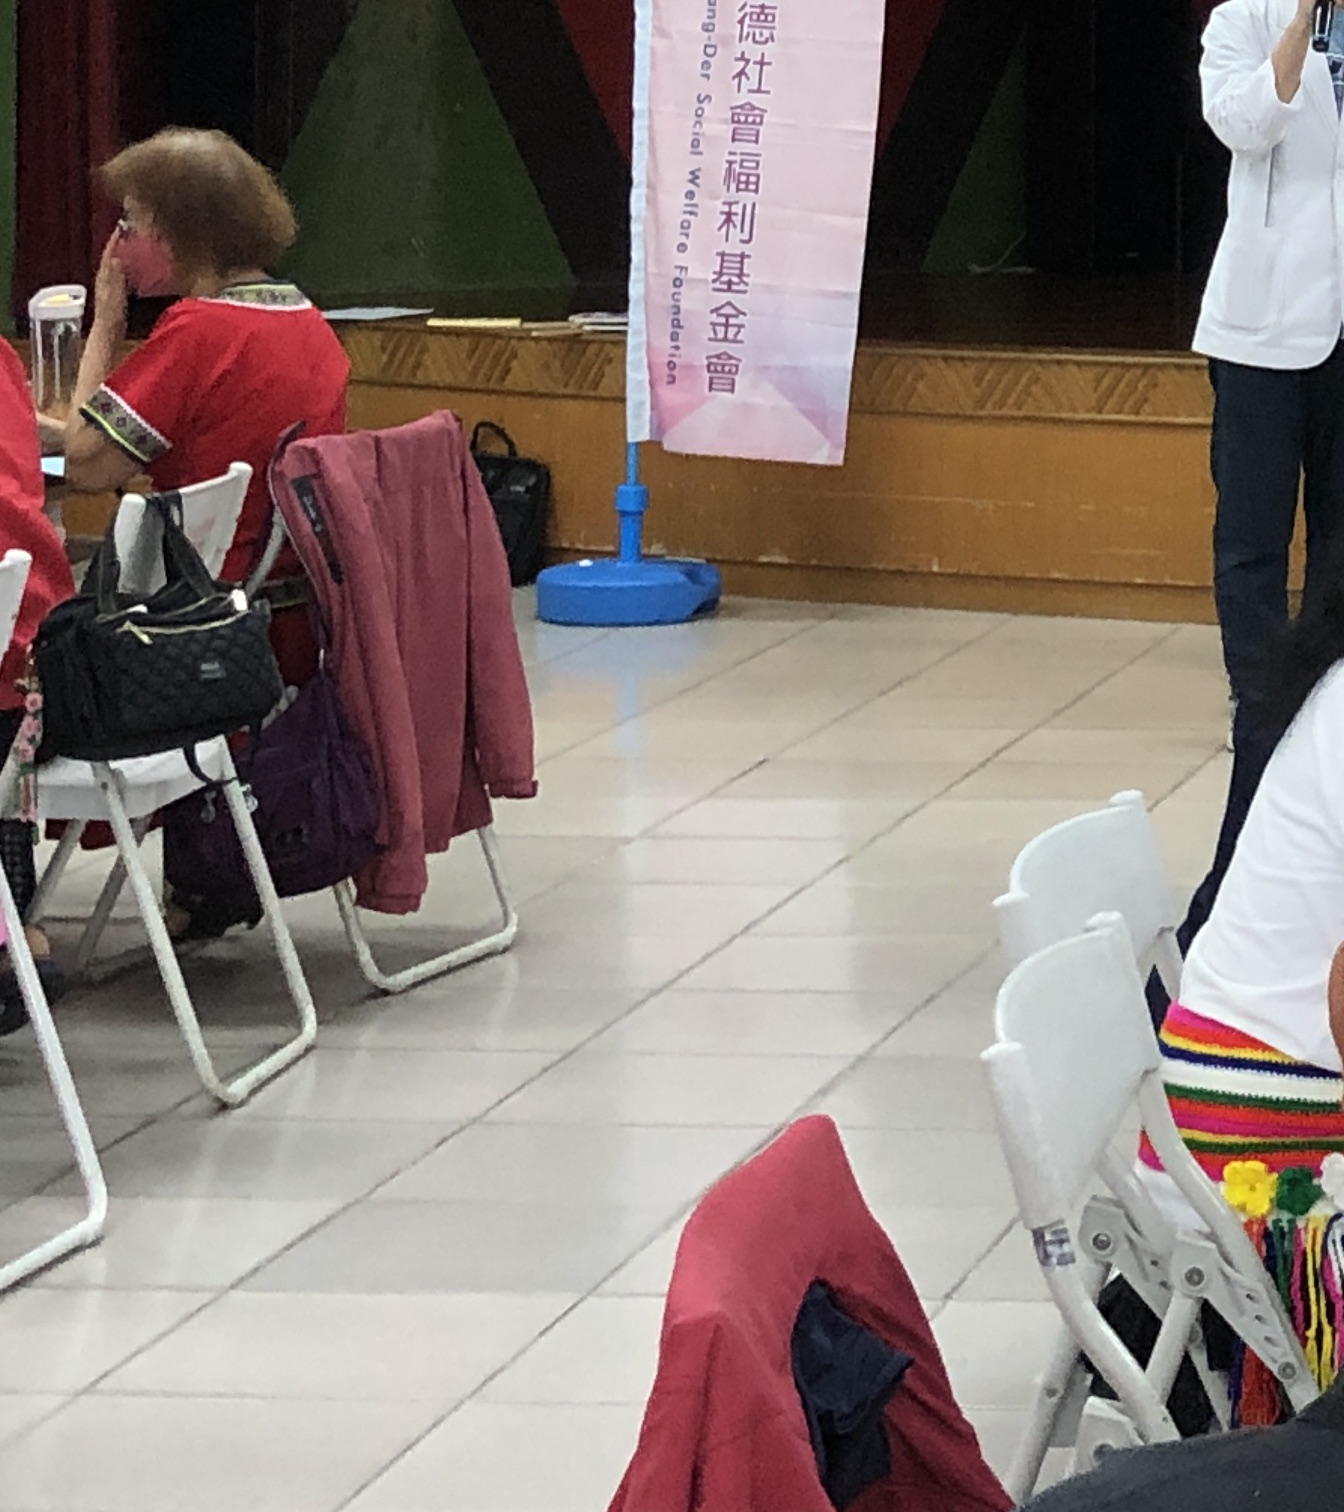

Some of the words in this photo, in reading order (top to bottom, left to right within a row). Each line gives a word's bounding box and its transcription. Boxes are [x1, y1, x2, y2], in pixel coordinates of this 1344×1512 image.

[689, 92, 713, 156] Social
[676, 167, 702, 255] Welfare
[665, 264, 689, 386] Foundation
